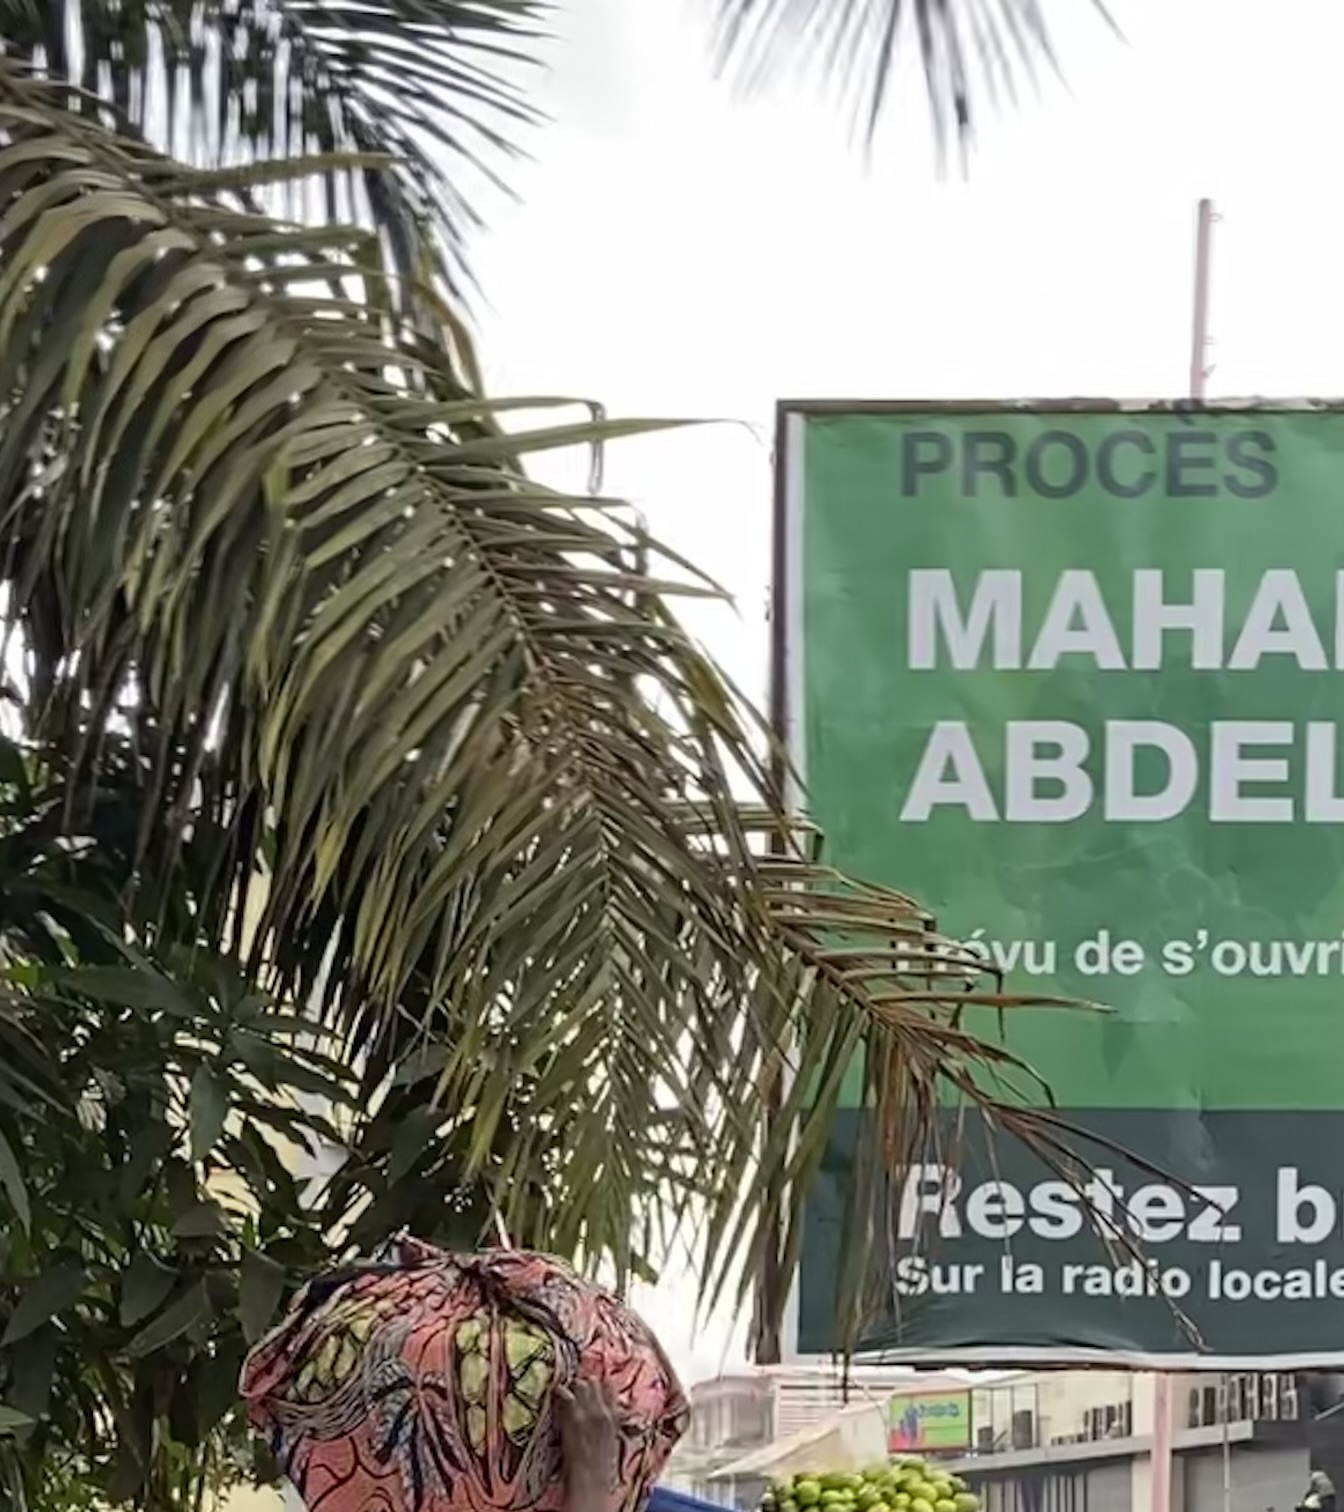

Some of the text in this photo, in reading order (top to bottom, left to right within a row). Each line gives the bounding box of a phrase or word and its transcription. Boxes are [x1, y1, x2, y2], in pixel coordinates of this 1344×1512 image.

[899, 404, 1280, 500] PROCÈS
[1074, 929, 1146, 976] de
[895, 1163, 1242, 1243] Restez
[894, 1255, 985, 1296] Sur
[1000, 1255, 1044, 1295] la
[1062, 1257, 1192, 1299] radio
